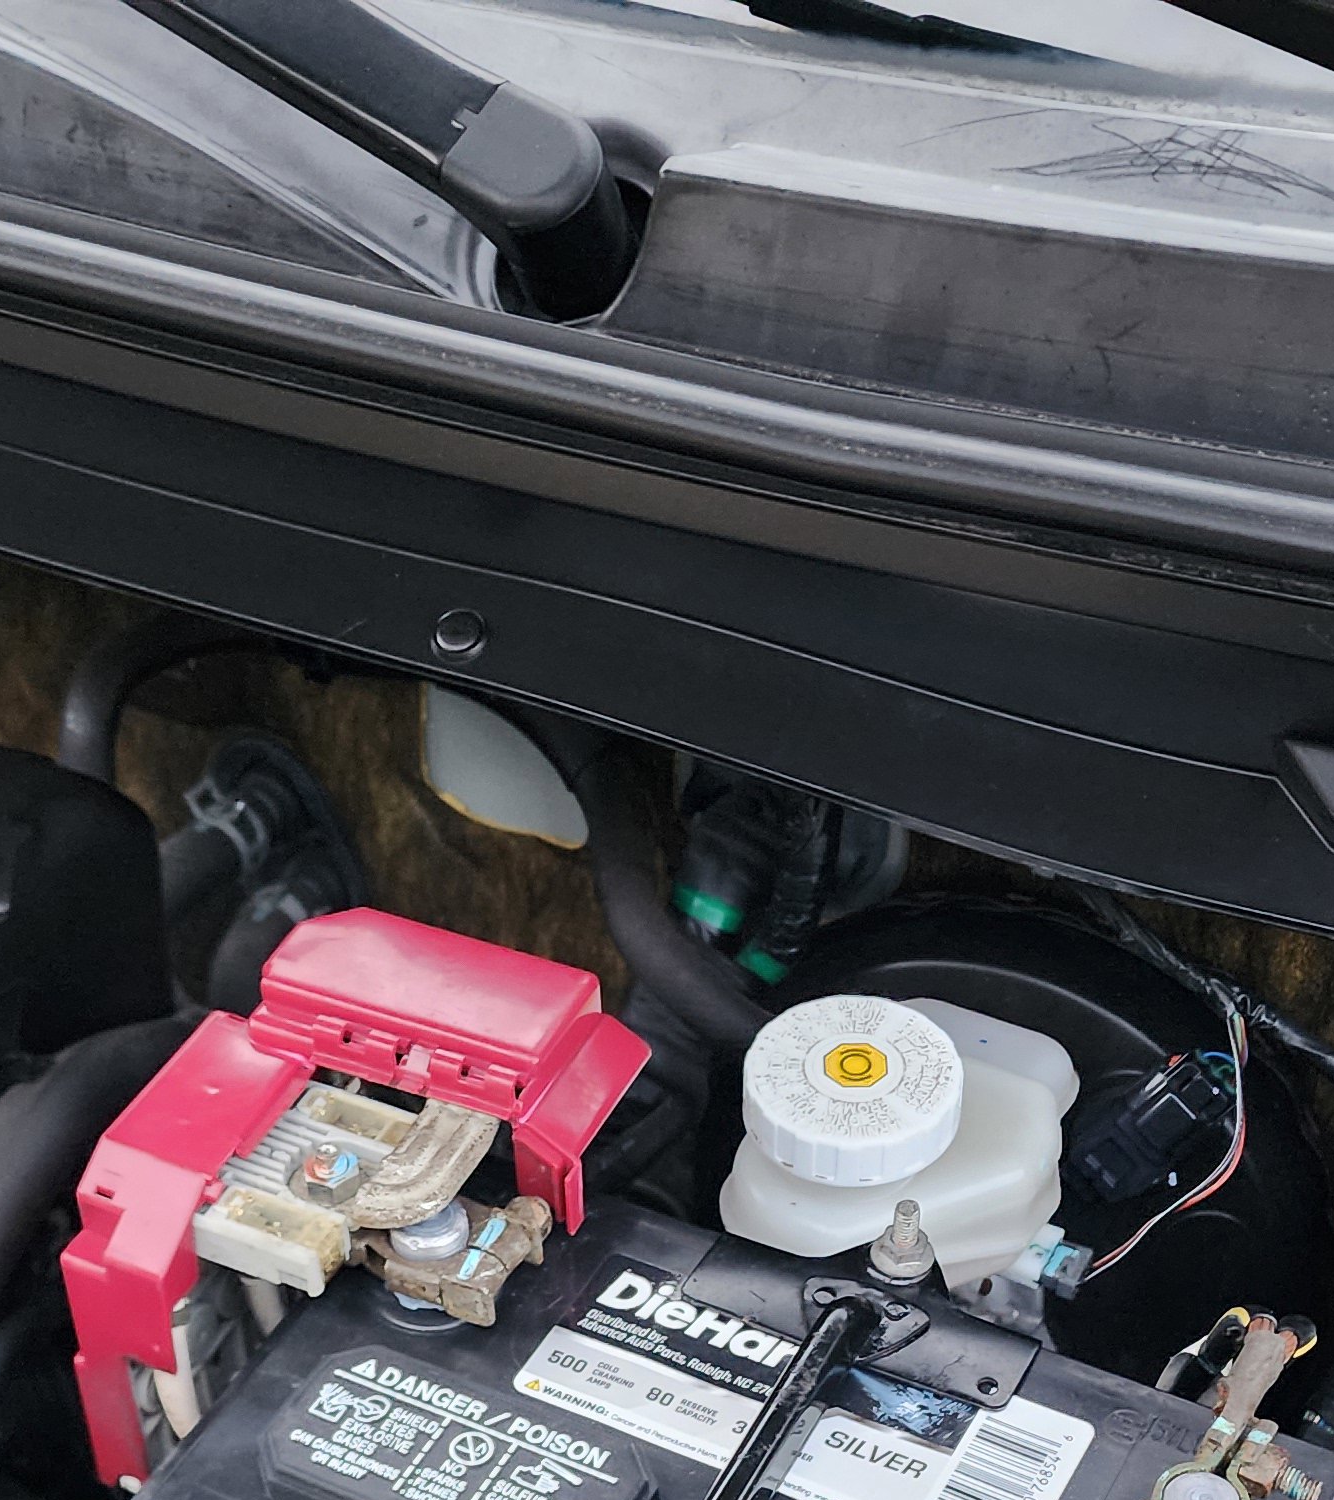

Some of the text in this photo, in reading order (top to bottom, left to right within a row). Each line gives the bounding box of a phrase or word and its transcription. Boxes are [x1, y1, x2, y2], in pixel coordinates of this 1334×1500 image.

[585, 1308, 668, 1344] Distributed by:
[595, 1269, 801, 1368] DieHar
[547, 1349, 589, 1374] 500
[577, 1318, 627, 1342] Advance
[625, 1335, 654, 1352] Auto
[652, 1344, 687, 1366] Parts,
[686, 1357, 732, 1383] Raleigh,
[732, 1375, 755, 1390] NC
[597, 1361, 620, 1373] COLD
[586, 1376, 612, 1390] AMPS
[591, 1369, 635, 1389] CRANKING
[646, 1387, 675, 1407] 80
[680, 1398, 719, 1417] RESERVE
[376, 1366, 488, 1422] DANGER
[507, 1419, 611, 1470] POISON
[389, 1407, 440, 1434] SHIELD
[542, 1385, 609, 1416] WARNING:
[610, 1413, 636, 1428] Cancer
[637, 1425, 652, 1434] and
[651, 1430, 697, 1452] Reproductive
[675, 1406, 718, 1426] CAPACITY
[341, 1417, 415, 1455] EXPLOSIVE
[380, 1419, 418, 1440] EYES
[289, 1428, 401, 1481] CAN CAUSE BLINDNESS
[332, 1430, 378, 1456] GASES
[824, 1430, 929, 1479] SILVER
[310, 1450, 368, 1480] OR INJURY
[440, 1459, 467, 1477] NO
[1029, 1456, 1062, 1493] 76854
[420, 1467, 467, 1493] SPARKS
